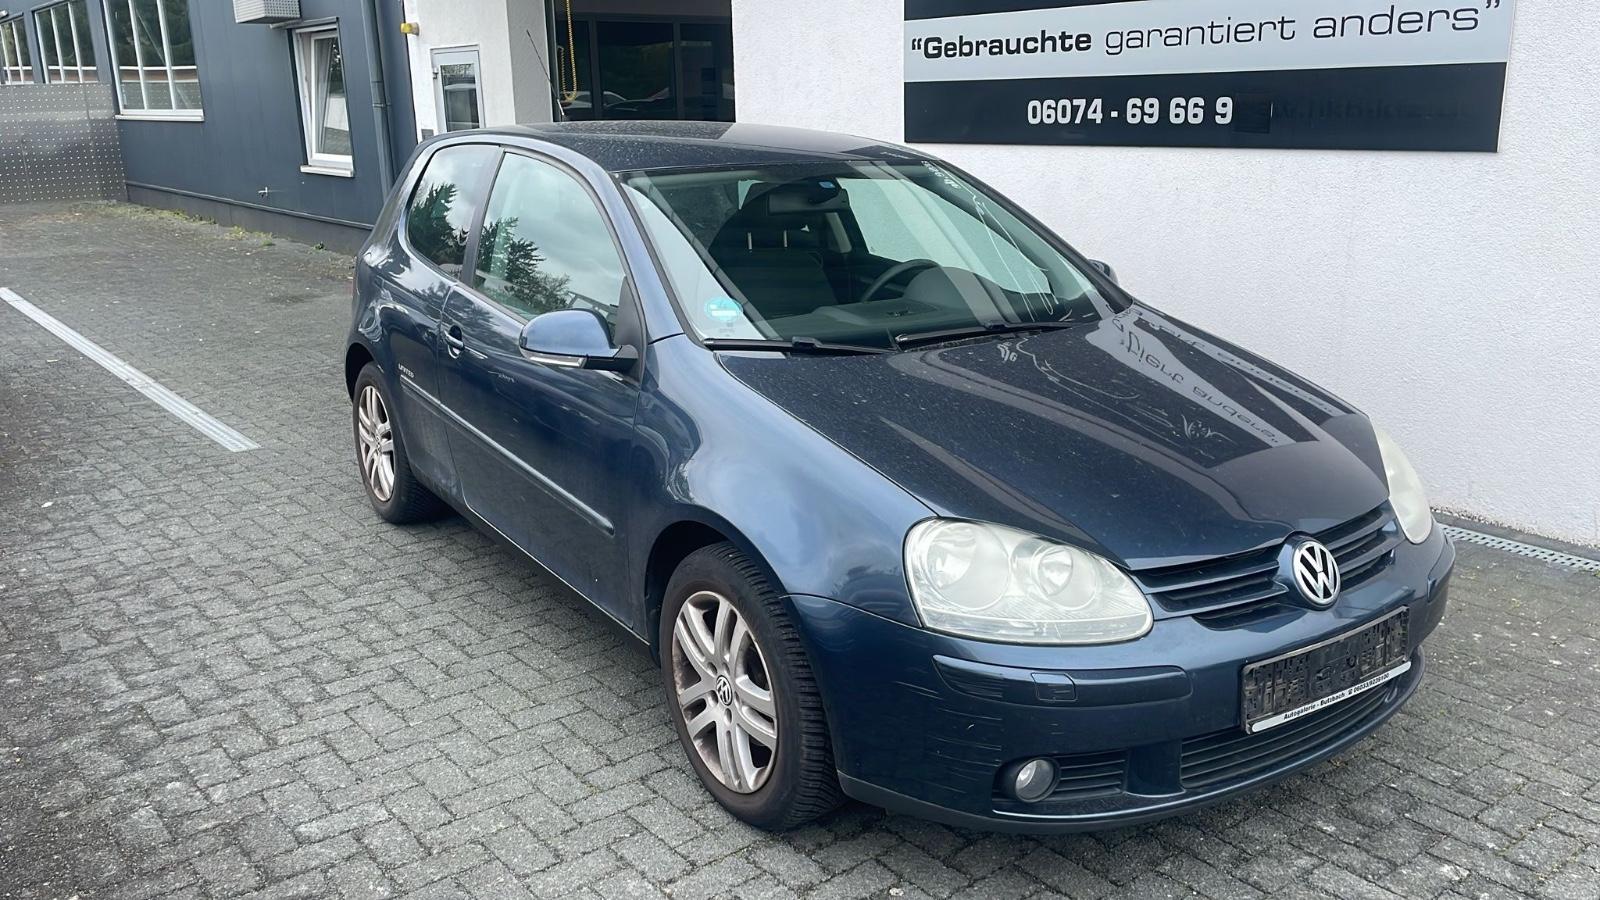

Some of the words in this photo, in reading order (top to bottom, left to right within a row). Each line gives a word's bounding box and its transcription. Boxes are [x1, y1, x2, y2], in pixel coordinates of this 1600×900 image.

[1105, 16, 1296, 56] garantiert
[1027, 98, 1103, 125] 06074
[1126, 97, 1160, 125] 69
[1169, 96, 1205, 125] 66
[1214, 96, 1234, 125] 9
[1293, 540, 1341, 605] VW
[1320, 692, 1345, 706] Butzbach
